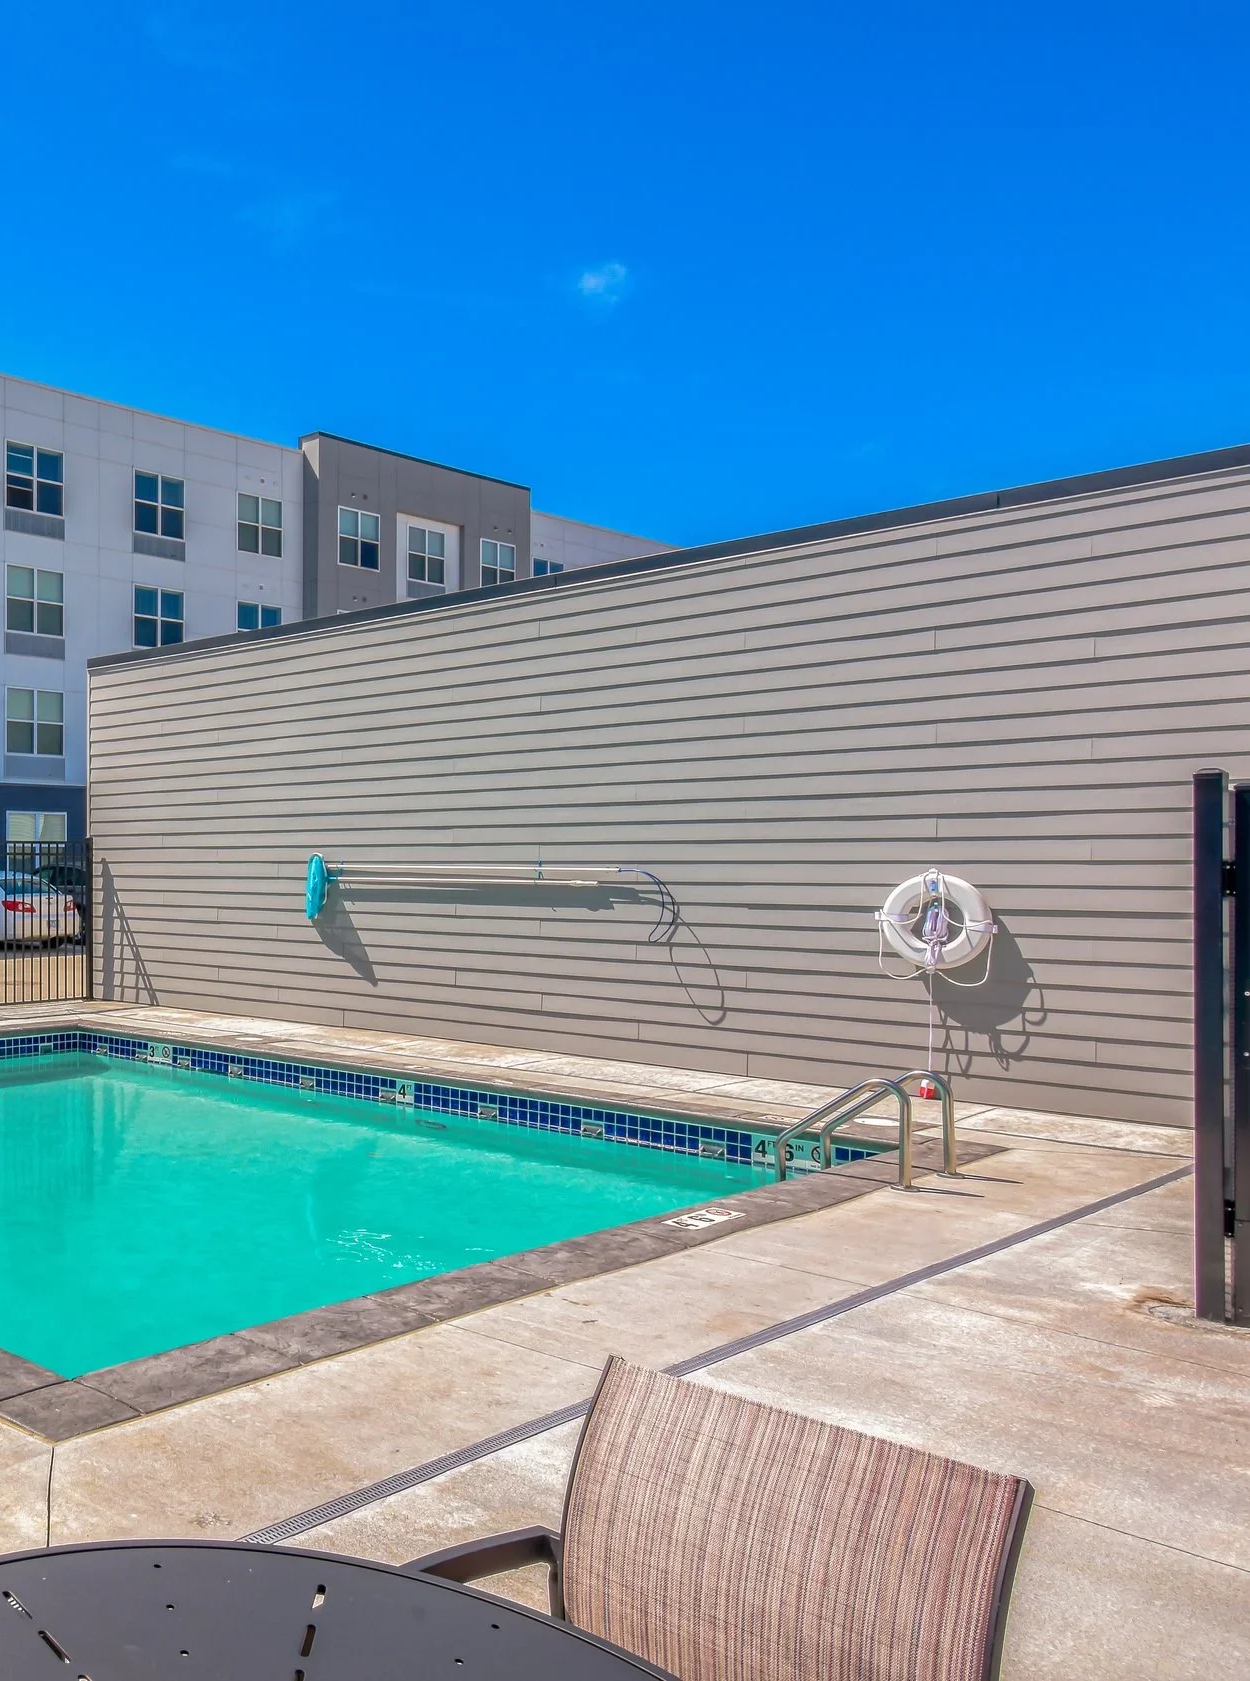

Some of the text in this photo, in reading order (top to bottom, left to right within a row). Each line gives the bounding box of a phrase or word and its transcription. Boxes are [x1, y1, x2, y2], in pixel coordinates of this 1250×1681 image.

[150, 1046, 155, 1058] 3
[398, 1084, 407, 1099] 4
[754, 1139, 768, 1159] 4
[784, 1143, 795, 1162] 6
[795, 1144, 805, 1153] IN
[687, 1215, 716, 1223] 6
